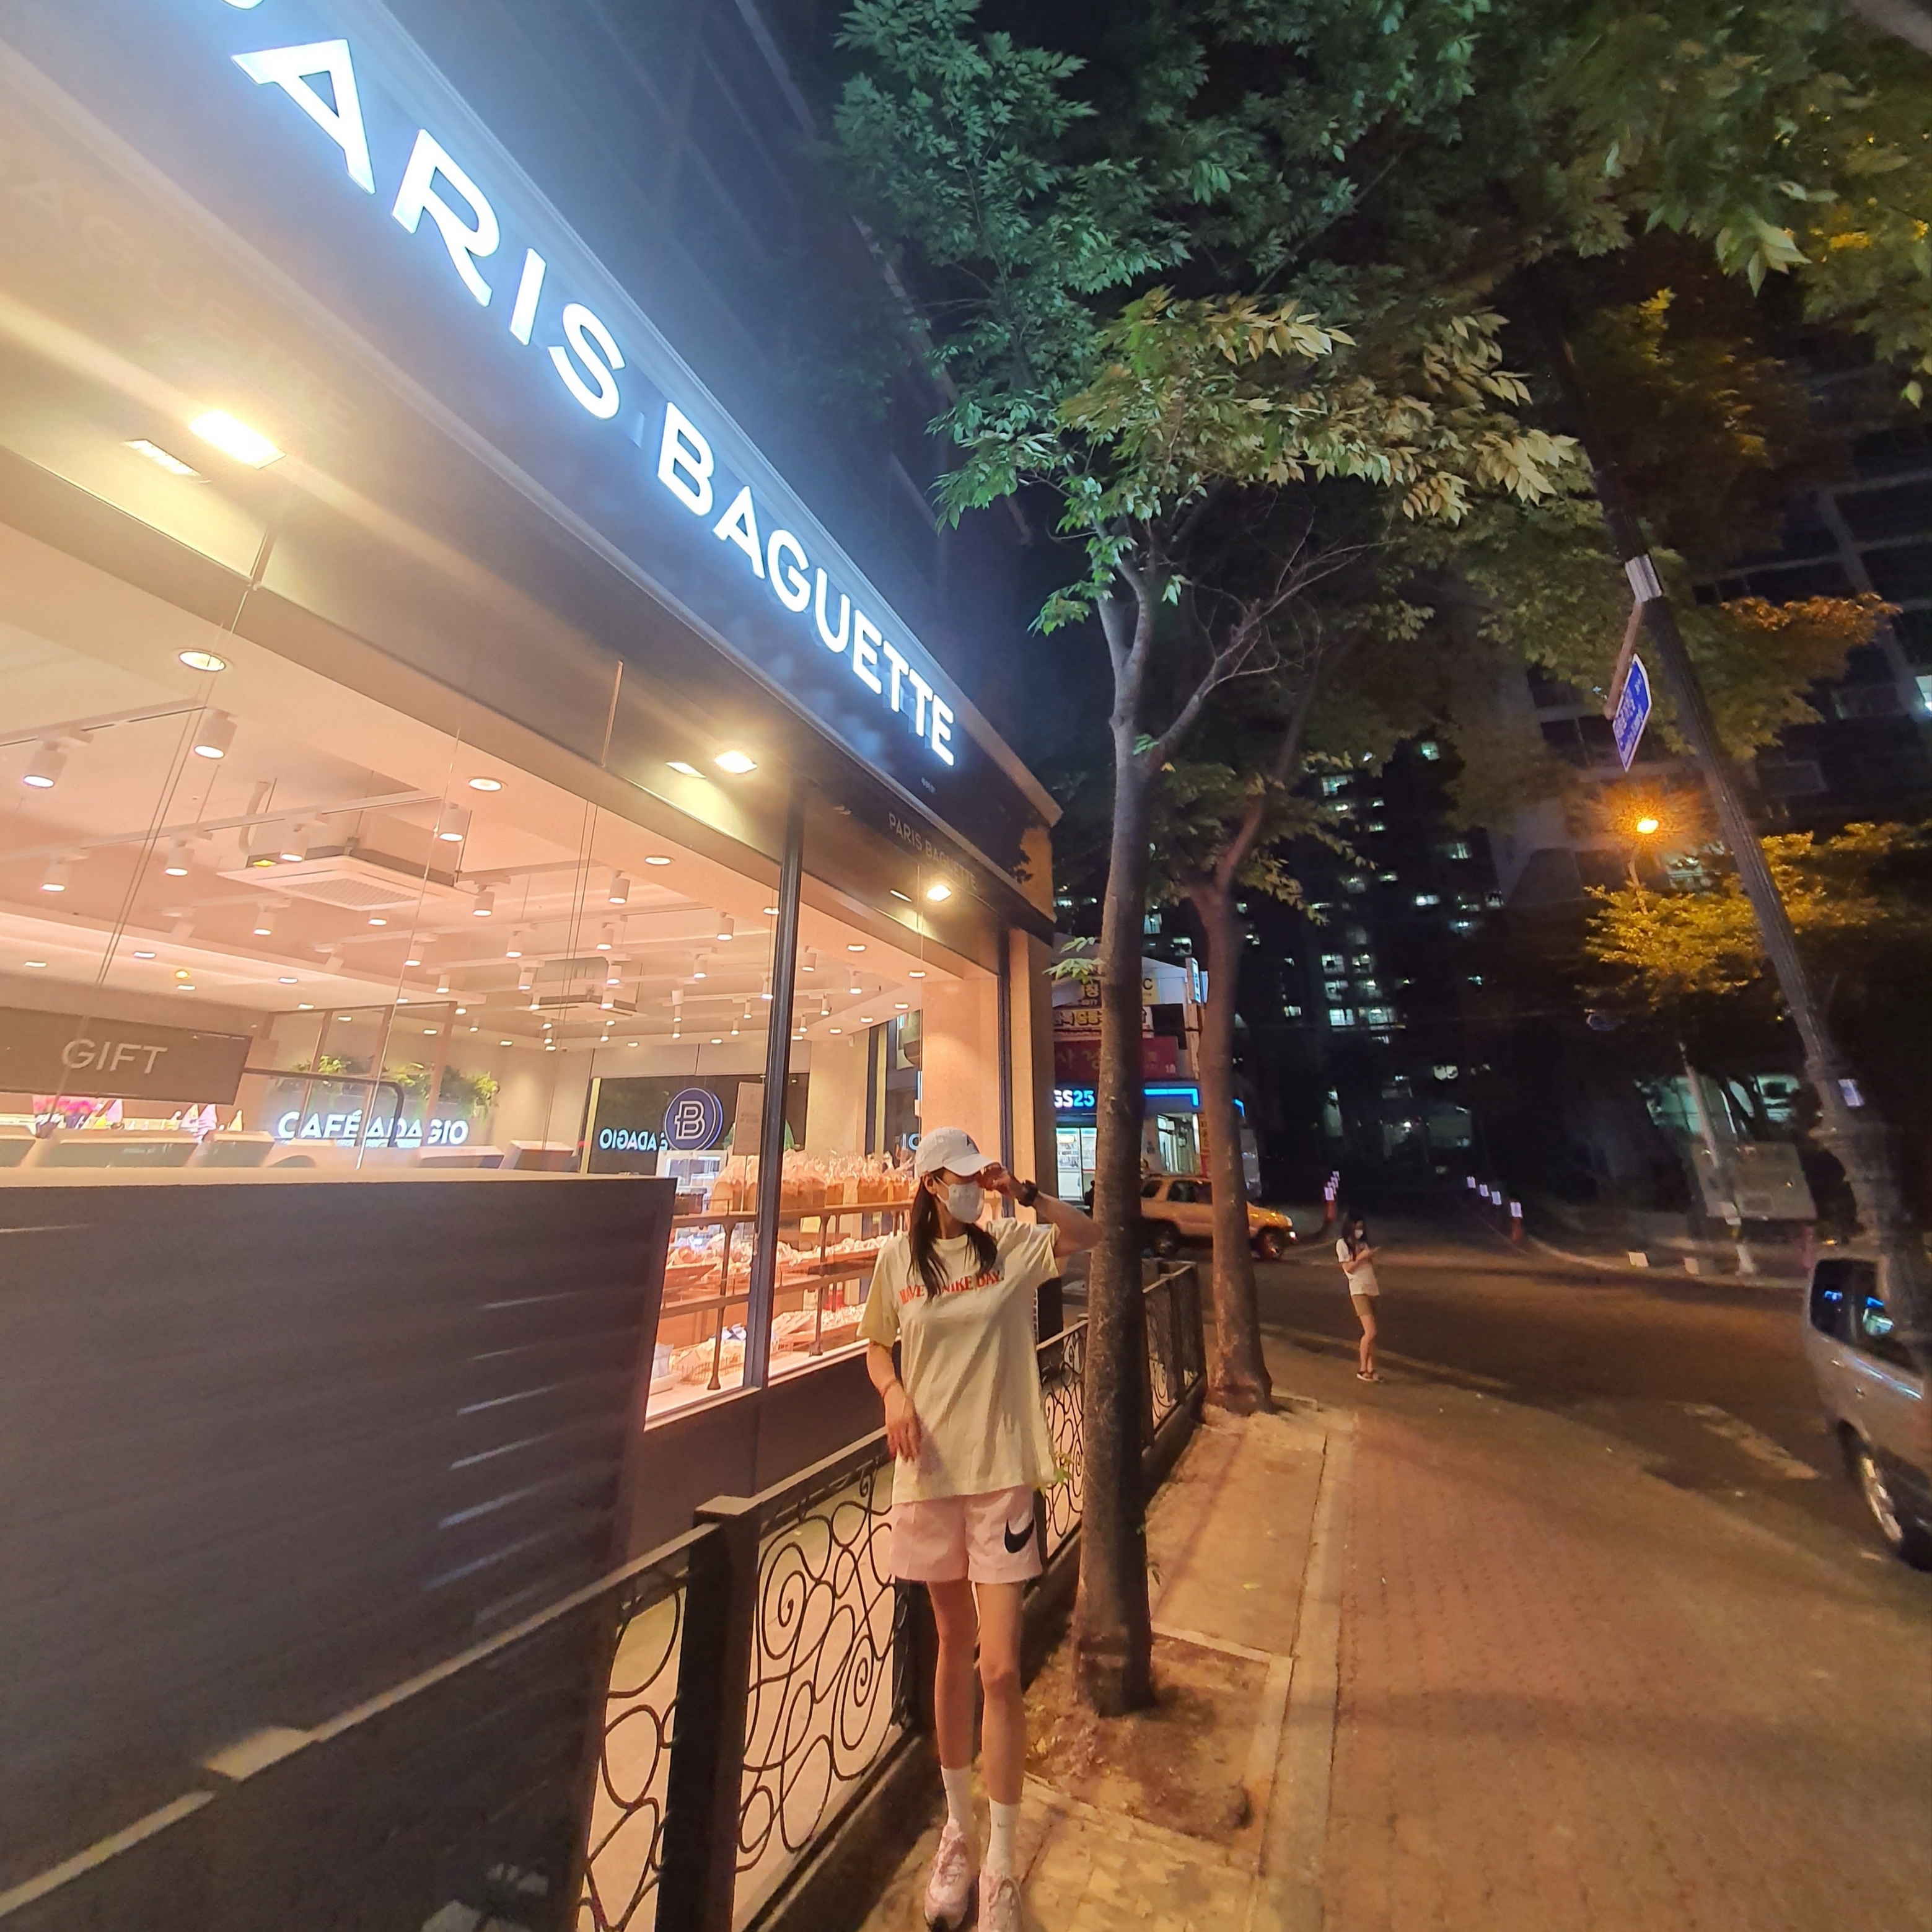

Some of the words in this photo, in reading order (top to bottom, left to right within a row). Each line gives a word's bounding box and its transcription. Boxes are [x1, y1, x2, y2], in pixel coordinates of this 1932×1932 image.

[220, 0, 626, 419] ARIS
[657, 402, 954, 766] BAGUETTE
[889, 811, 923, 851] PARIS
[925, 840, 977, 891] BAGUETTE
[62, 1038, 168, 1075] GIFT
[278, 1109, 363, 1139] CAFÉ
